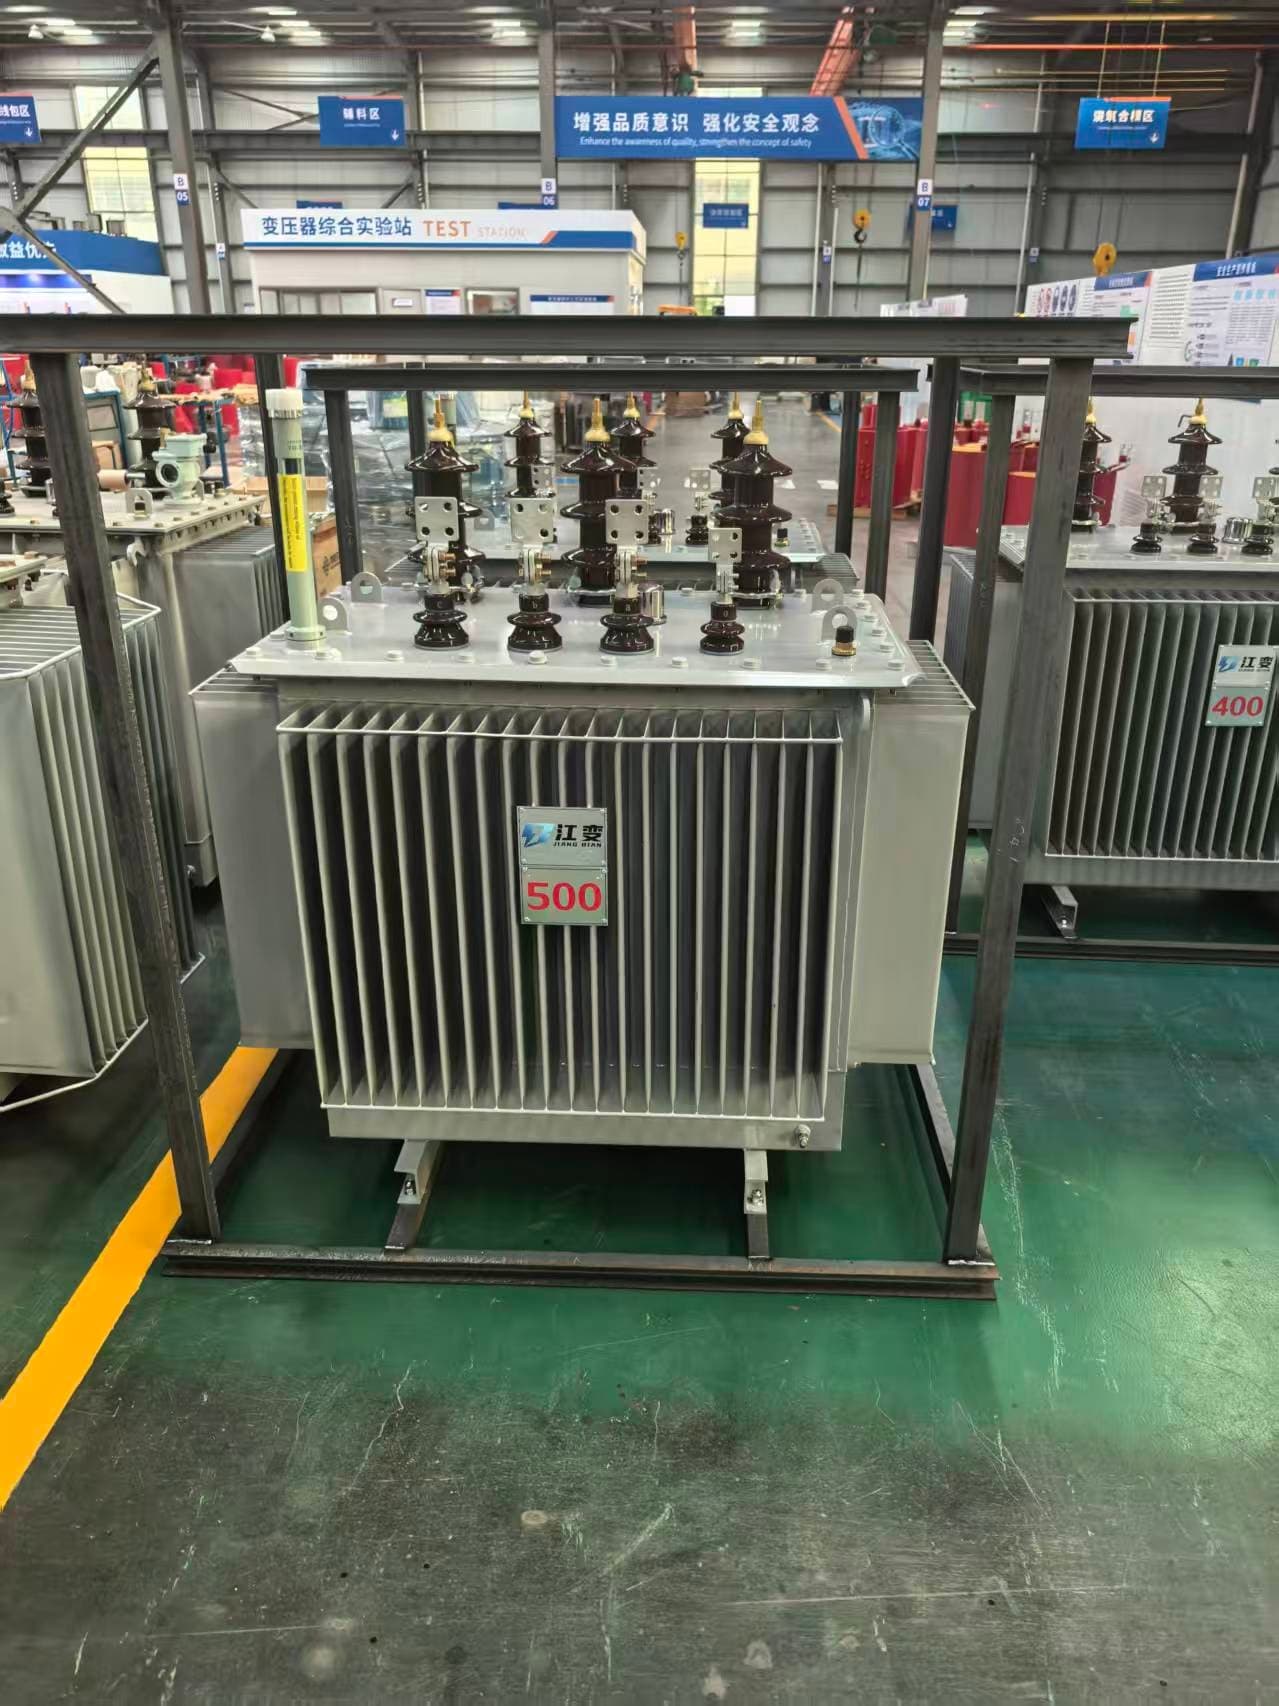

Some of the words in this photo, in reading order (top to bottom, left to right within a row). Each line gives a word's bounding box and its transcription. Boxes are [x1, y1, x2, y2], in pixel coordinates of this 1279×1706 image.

[573, 112, 688, 132] 增强品质意识
[703, 112, 819, 132] 强化安全观念
[612, 137, 623, 145] the
[663, 137, 672, 145] of
[739, 138, 750, 146] the
[781, 138, 789, 146] of
[177, 176, 184, 187] B
[545, 181, 552, 191] B
[921, 182, 928, 193] B
[177, 192, 188, 201] 05
[544, 196, 555, 206] 06
[918, 197, 930, 207] 07
[262, 216, 412, 236] 变压器综合实验站
[423, 221, 471, 237] TEST
[1240, 656, 1273, 669] 江变
[1211, 696, 1264, 716] 400
[555, 824, 603, 841] 江变
[527, 882, 602, 912] 500
